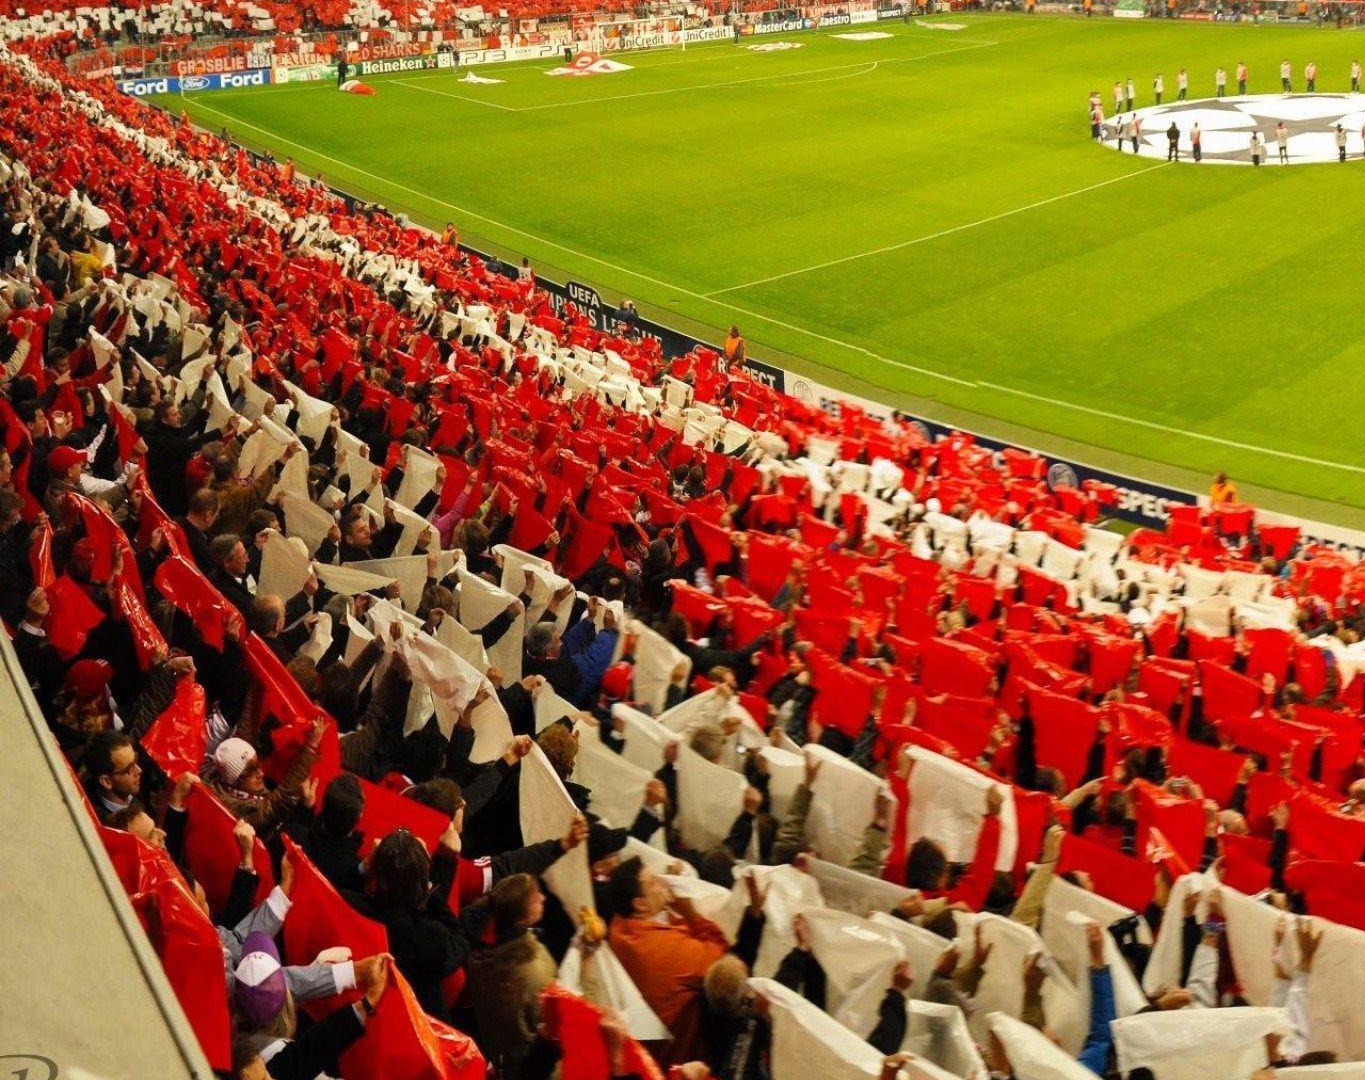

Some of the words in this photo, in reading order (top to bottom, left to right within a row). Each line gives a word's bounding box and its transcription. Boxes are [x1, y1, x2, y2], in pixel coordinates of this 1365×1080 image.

[754, 19, 802, 34] MasterCard
[373, 43, 421, 59] SHARKS
[465, 50, 507, 64] PS3
[362, 57, 424, 75] Heineken
[123, 79, 168, 96] Ford
[220, 70, 264, 88] Ford
[569, 284, 600, 309] UEFA
